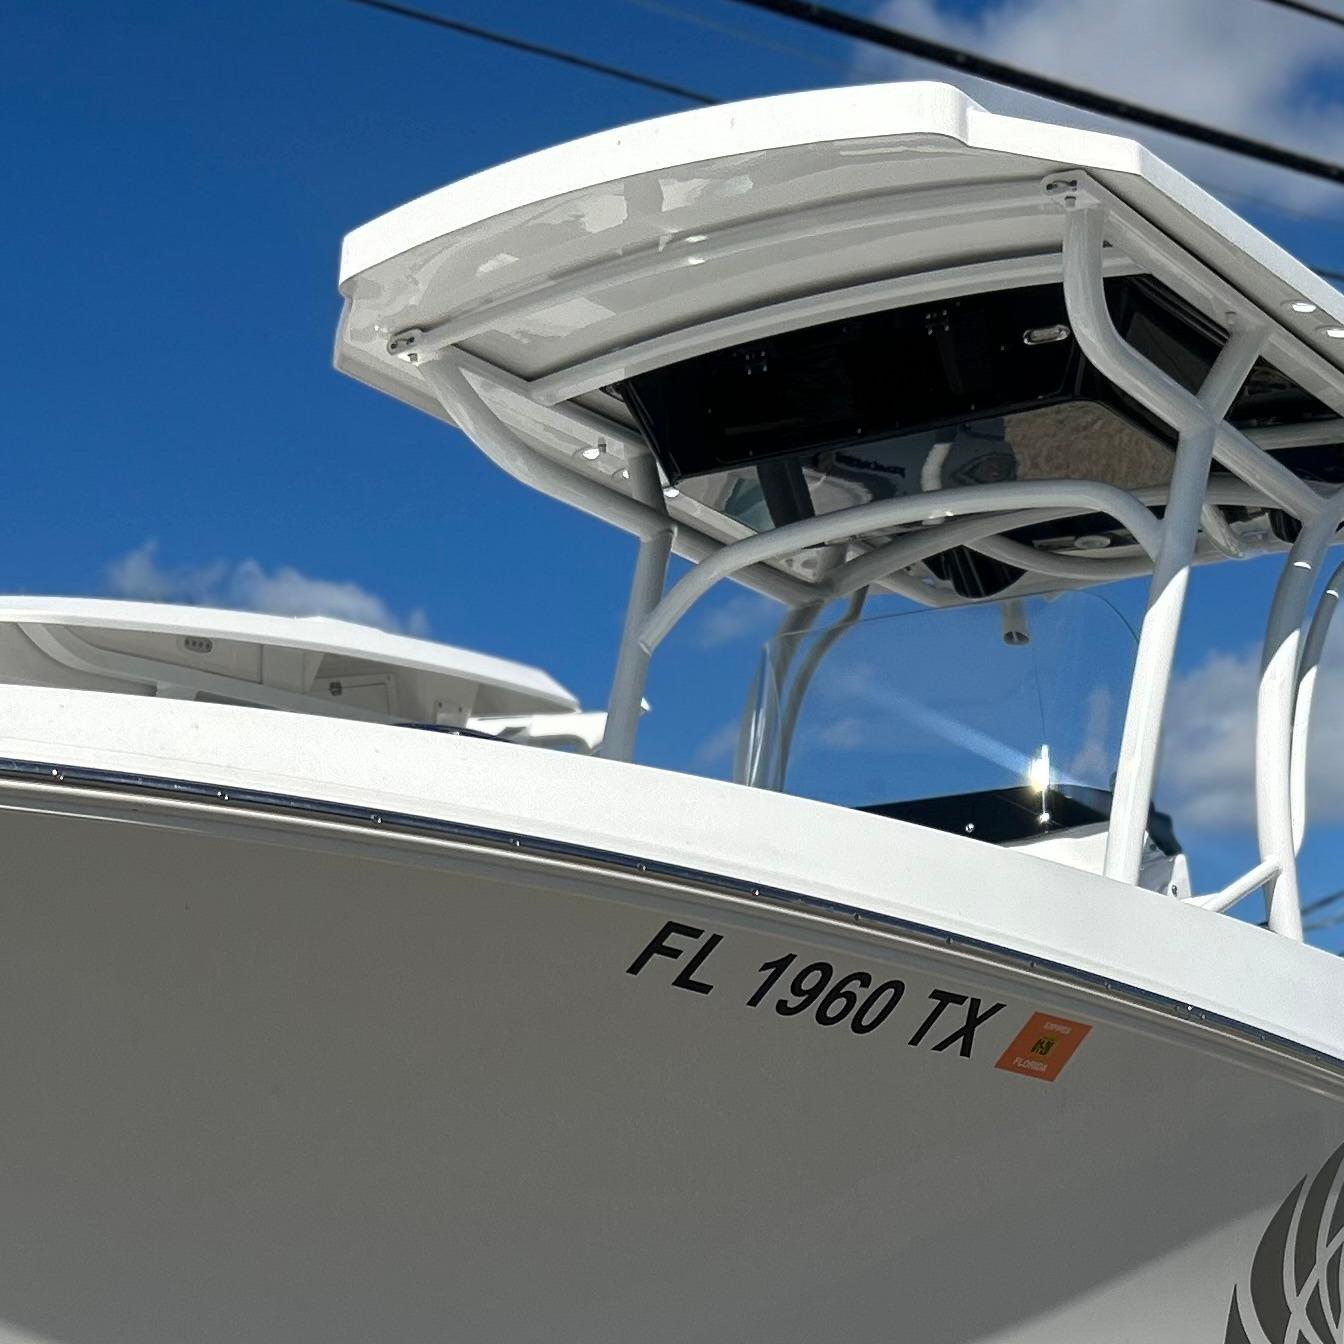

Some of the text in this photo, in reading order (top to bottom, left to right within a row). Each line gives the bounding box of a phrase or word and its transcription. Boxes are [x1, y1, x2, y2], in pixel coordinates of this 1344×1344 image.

[625, 920, 1007, 1060] FL 1960 TX
